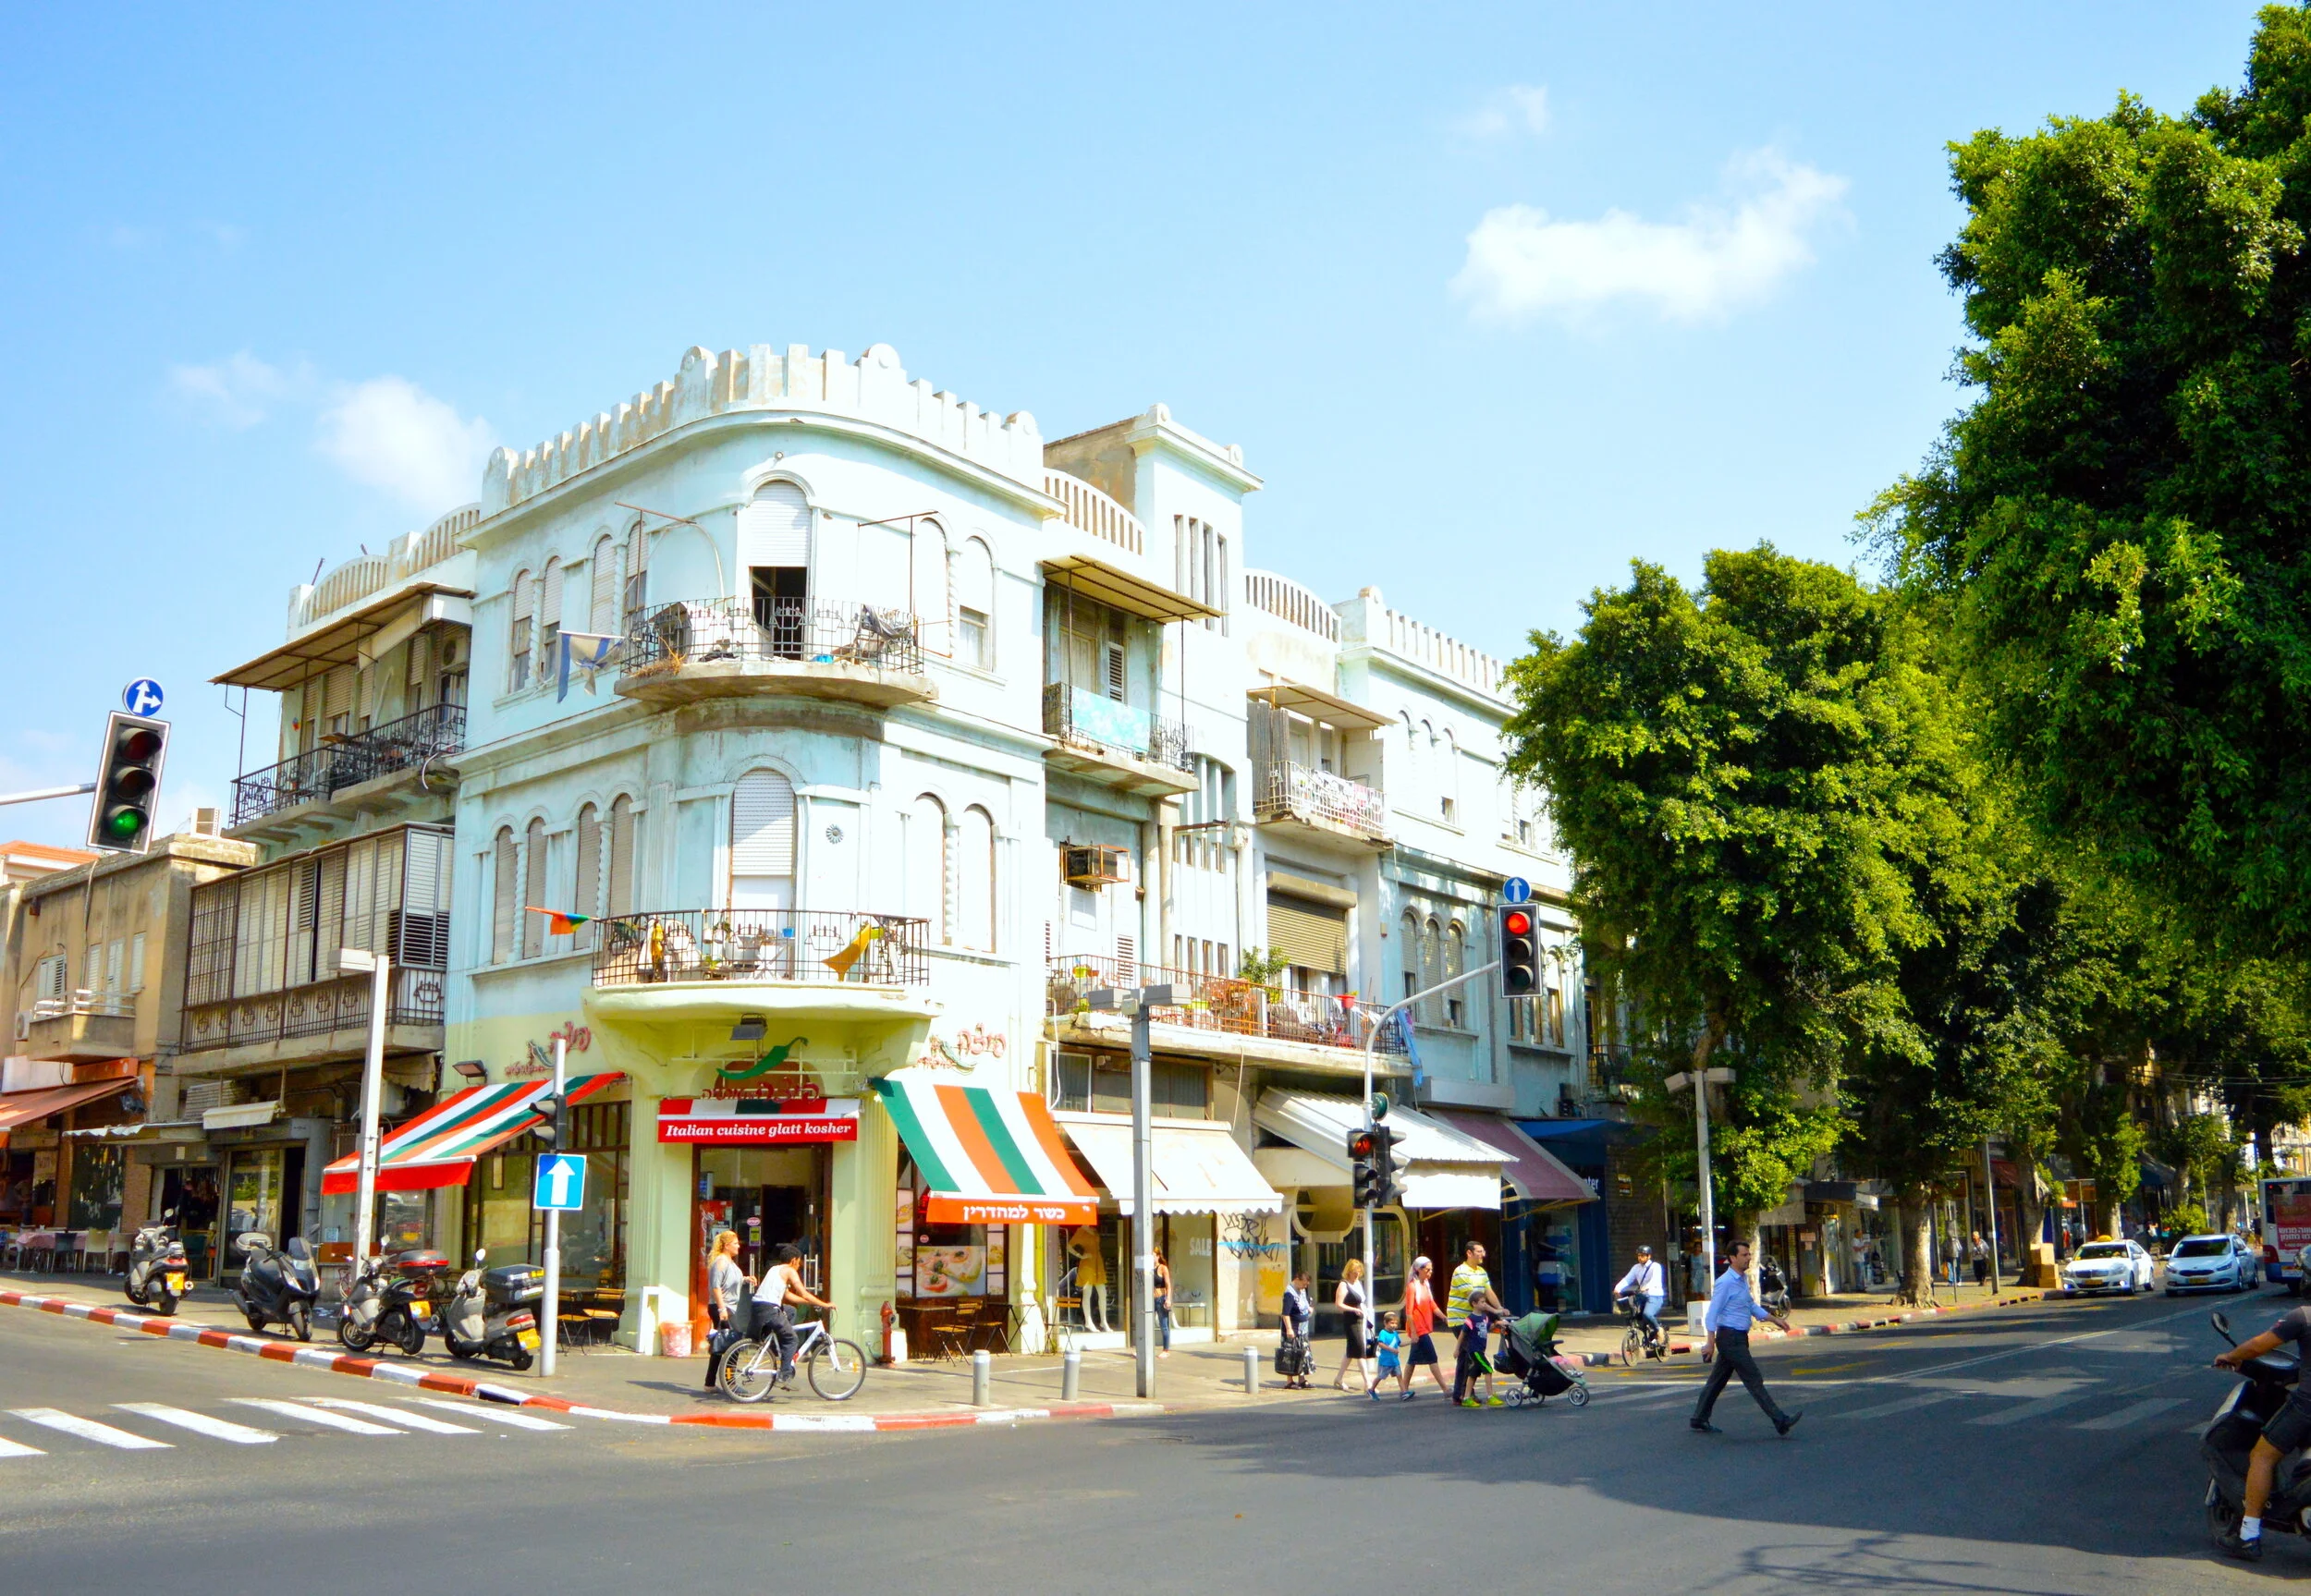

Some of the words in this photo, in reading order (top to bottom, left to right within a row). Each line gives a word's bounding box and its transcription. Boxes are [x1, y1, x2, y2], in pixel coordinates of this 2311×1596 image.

[666, 1125, 714, 1137] Italian
[716, 1125, 766, 1136] cuisine
[768, 1124, 802, 1138] glatt
[804, 1122, 851, 1135] kosher
[962, 1204, 1029, 1221] למהדרין
[1033, 1206, 1066, 1220] כשר
